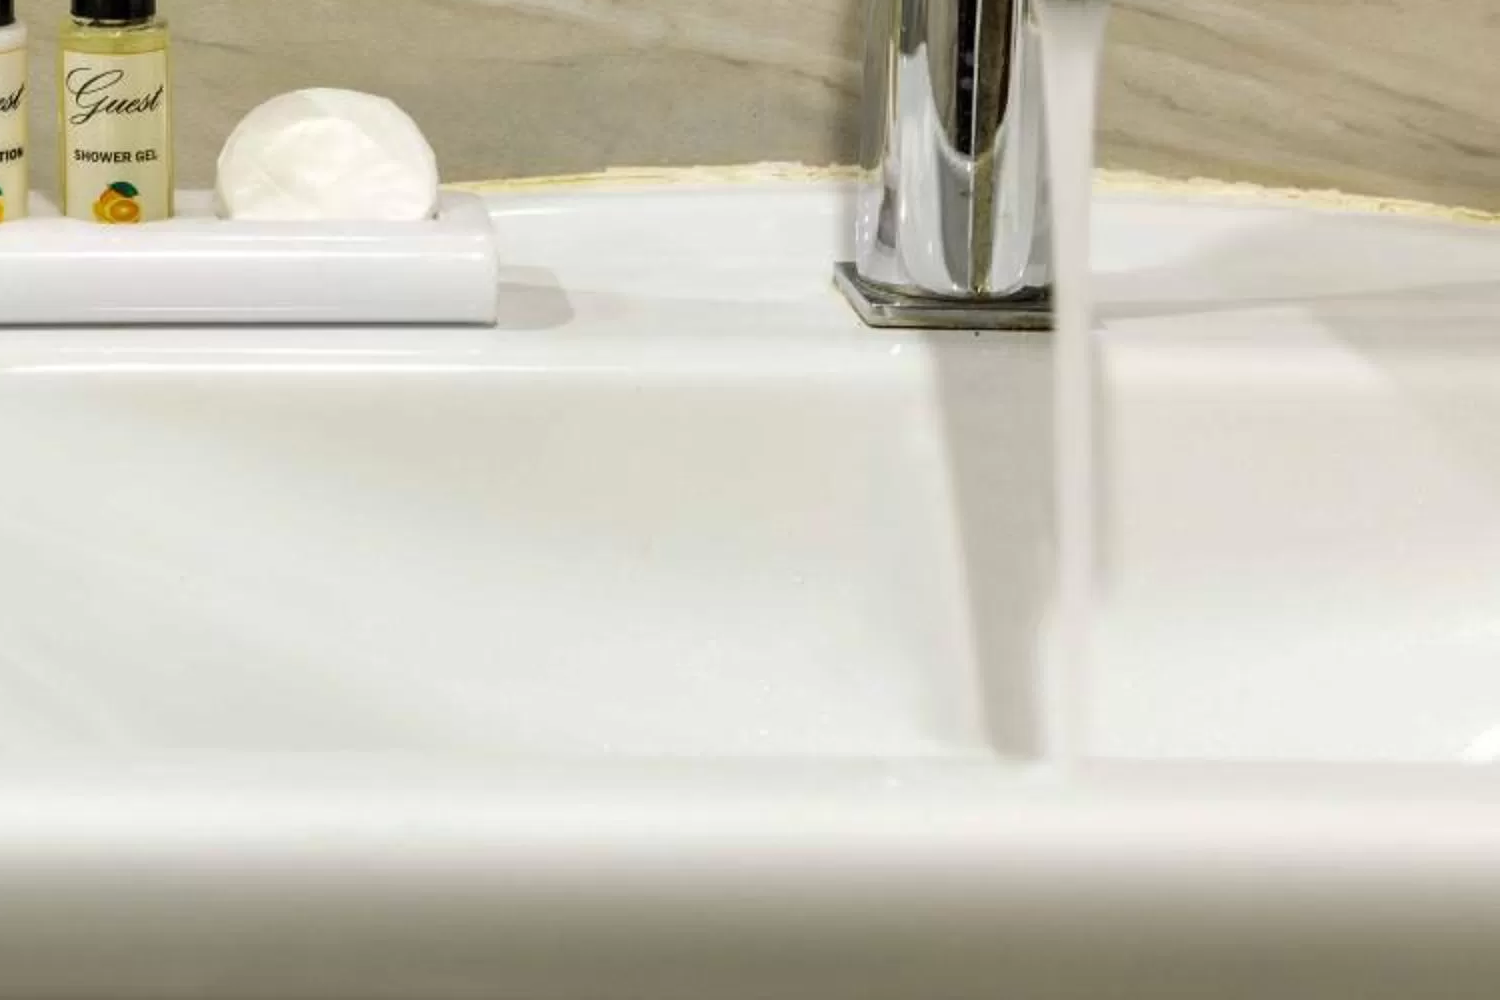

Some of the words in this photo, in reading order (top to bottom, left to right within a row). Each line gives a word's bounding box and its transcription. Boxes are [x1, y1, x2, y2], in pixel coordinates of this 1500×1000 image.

[65, 67, 164, 126] Guest
[74, 149, 132, 163] SHOWER
[134, 149, 158, 163] GEL
